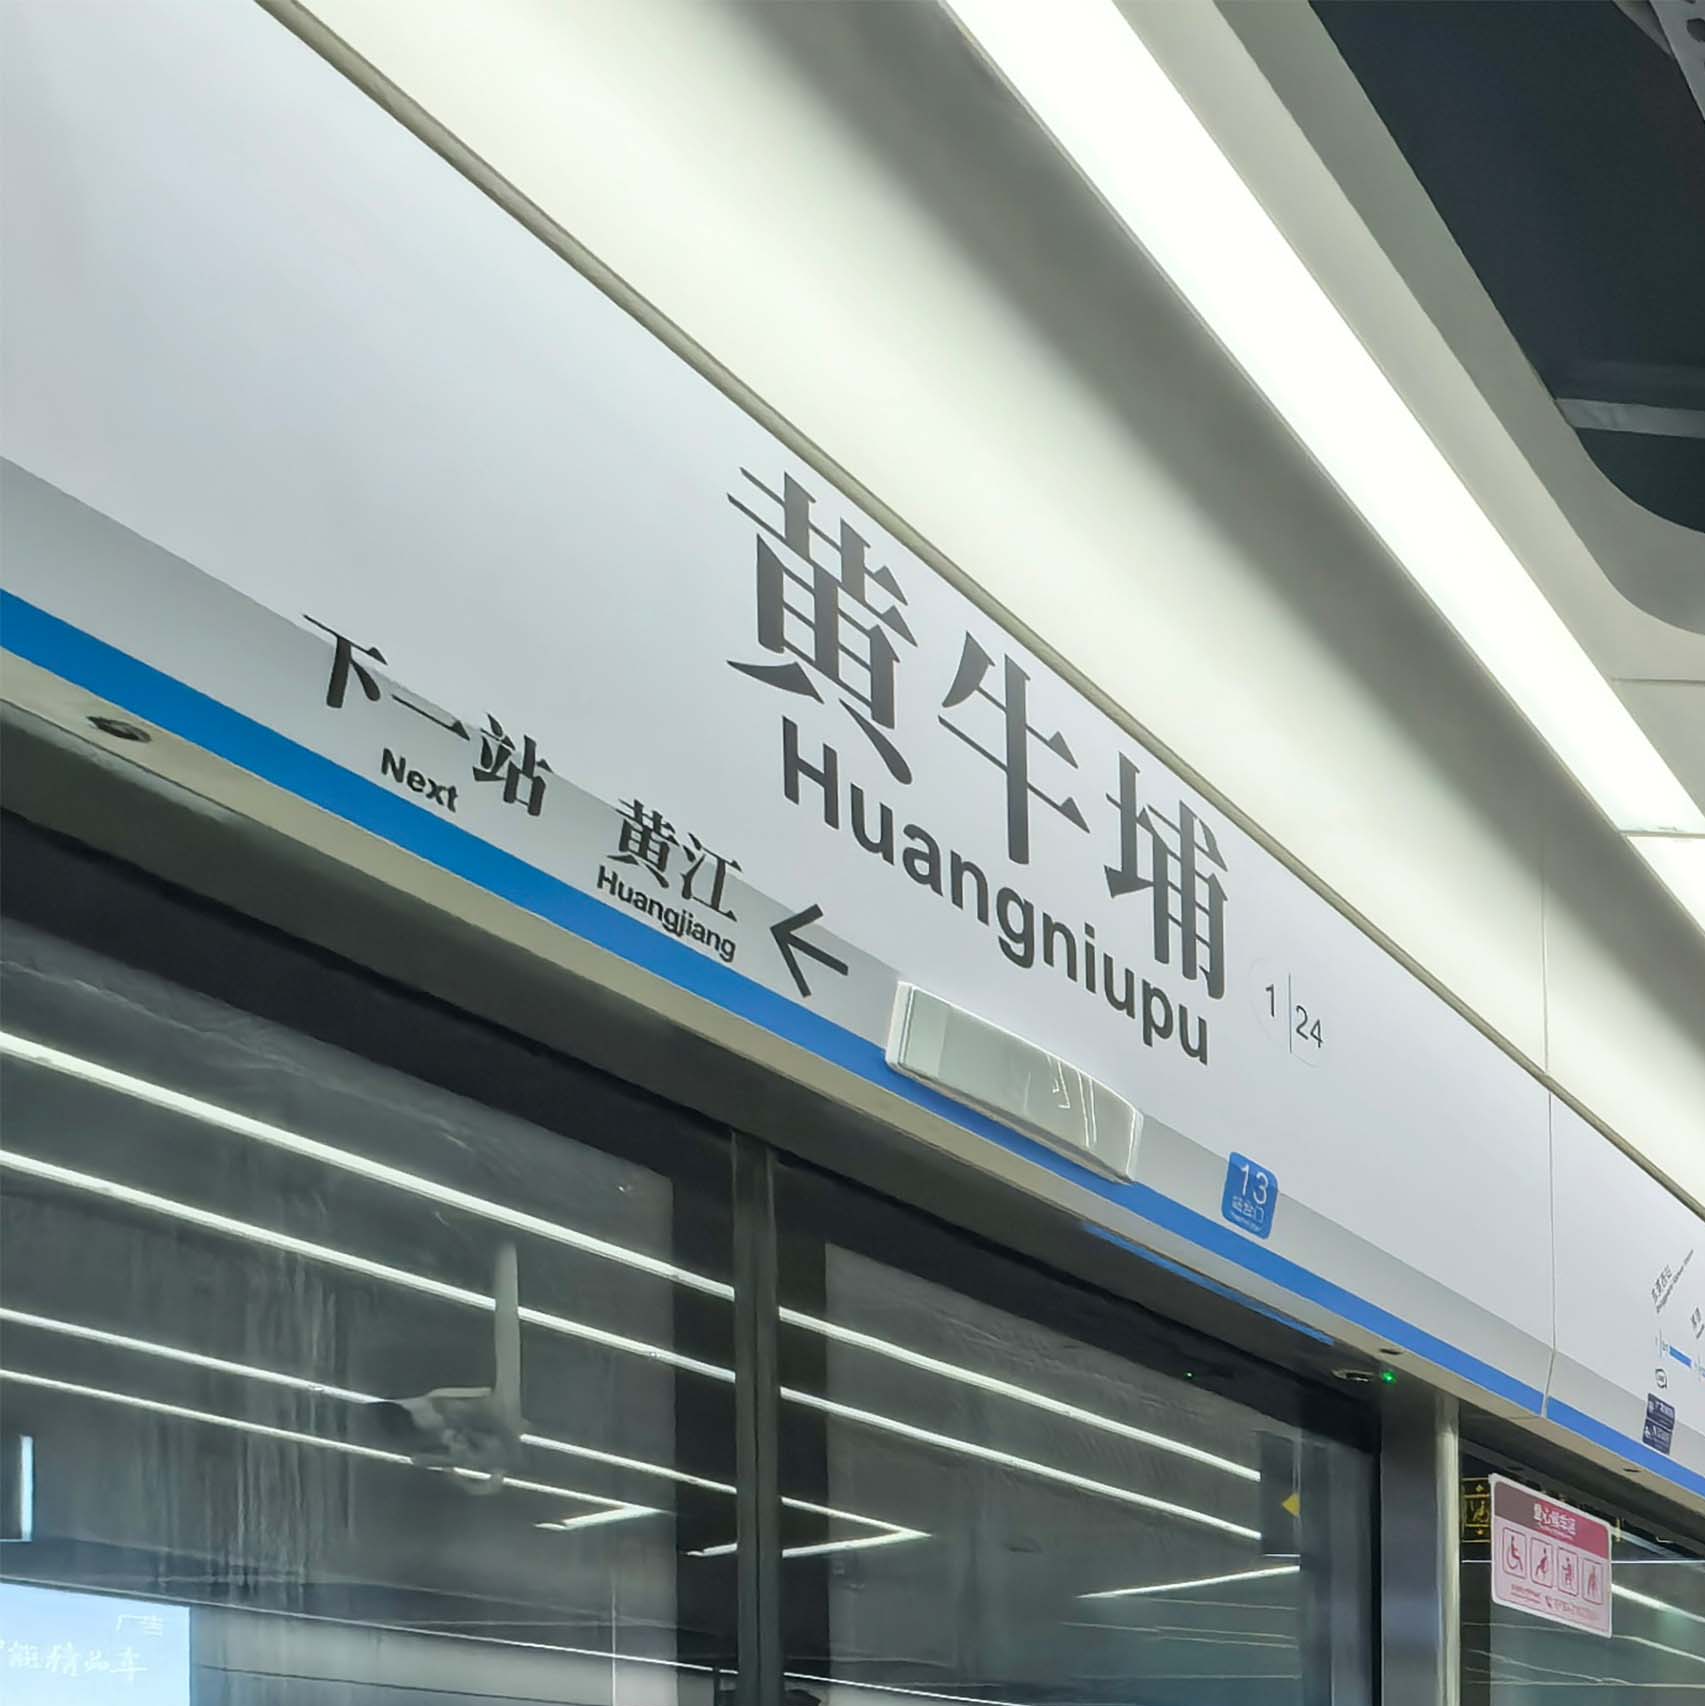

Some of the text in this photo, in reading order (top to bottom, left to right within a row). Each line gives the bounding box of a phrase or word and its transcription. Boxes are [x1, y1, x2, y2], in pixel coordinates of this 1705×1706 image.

[302, 614, 743, 923] 下一站 黄江
[381, 747, 737, 964] Next Huangjiang
[726, 466, 1229, 1000] 黄牛埔
[782, 715, 1209, 1066] Huangniupu
[1240, 1163, 1269, 1205] 13
